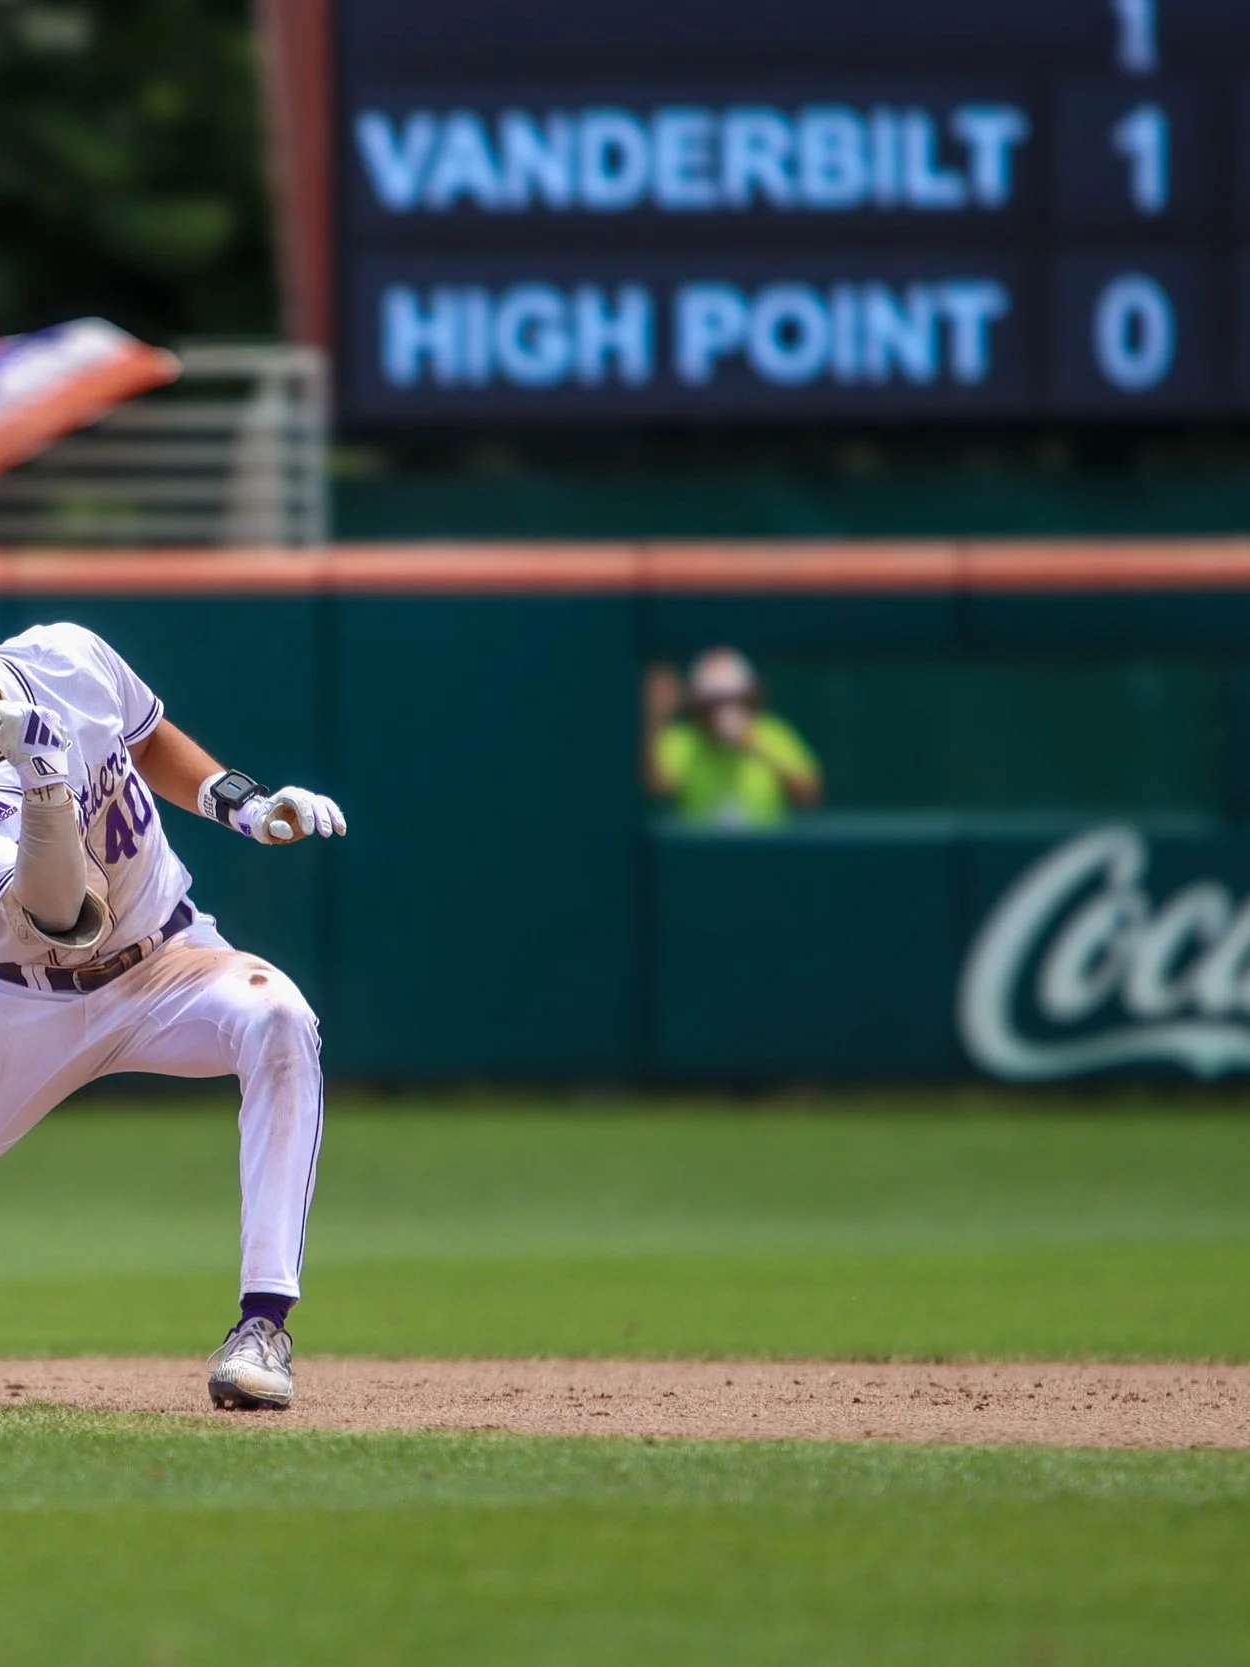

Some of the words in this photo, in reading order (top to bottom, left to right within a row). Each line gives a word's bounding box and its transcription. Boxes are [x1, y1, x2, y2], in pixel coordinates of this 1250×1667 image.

[355, 102, 1028, 213] VANDERBILT
[1112, 103, 1169, 212] 1
[378, 279, 656, 389] HIGH
[671, 277, 1009, 388] POINT
[1092, 273, 1176, 391] 0
[104, 771, 152, 864] 40
